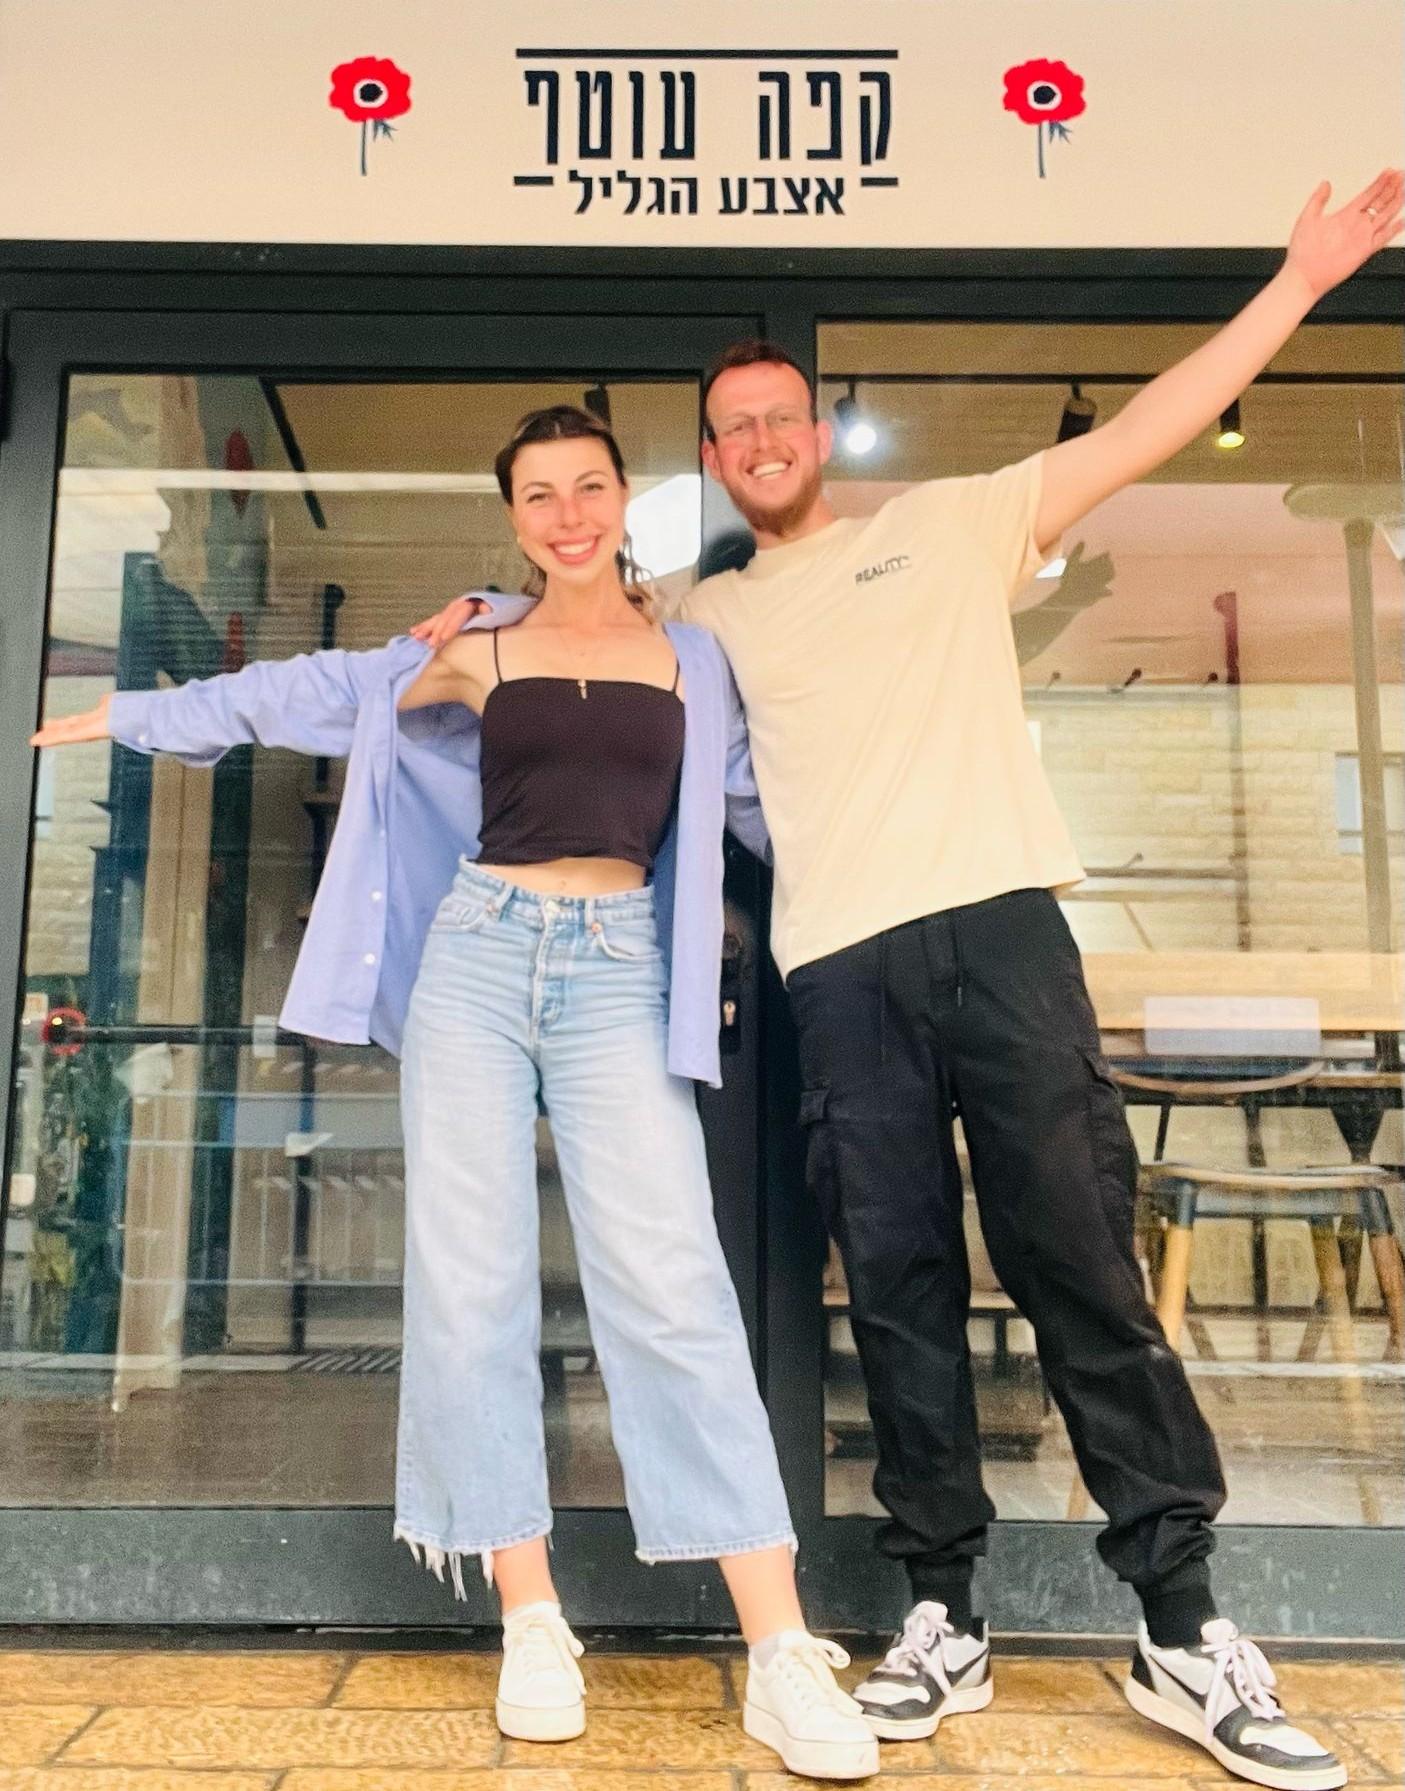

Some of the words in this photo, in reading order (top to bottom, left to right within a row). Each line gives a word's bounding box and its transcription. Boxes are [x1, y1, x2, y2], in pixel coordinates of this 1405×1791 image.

[524, 70, 696, 165] עוטף
[758, 70, 891, 165] קפה
[568, 169, 698, 215] הגליל
[718, 176, 845, 215] אצבע
